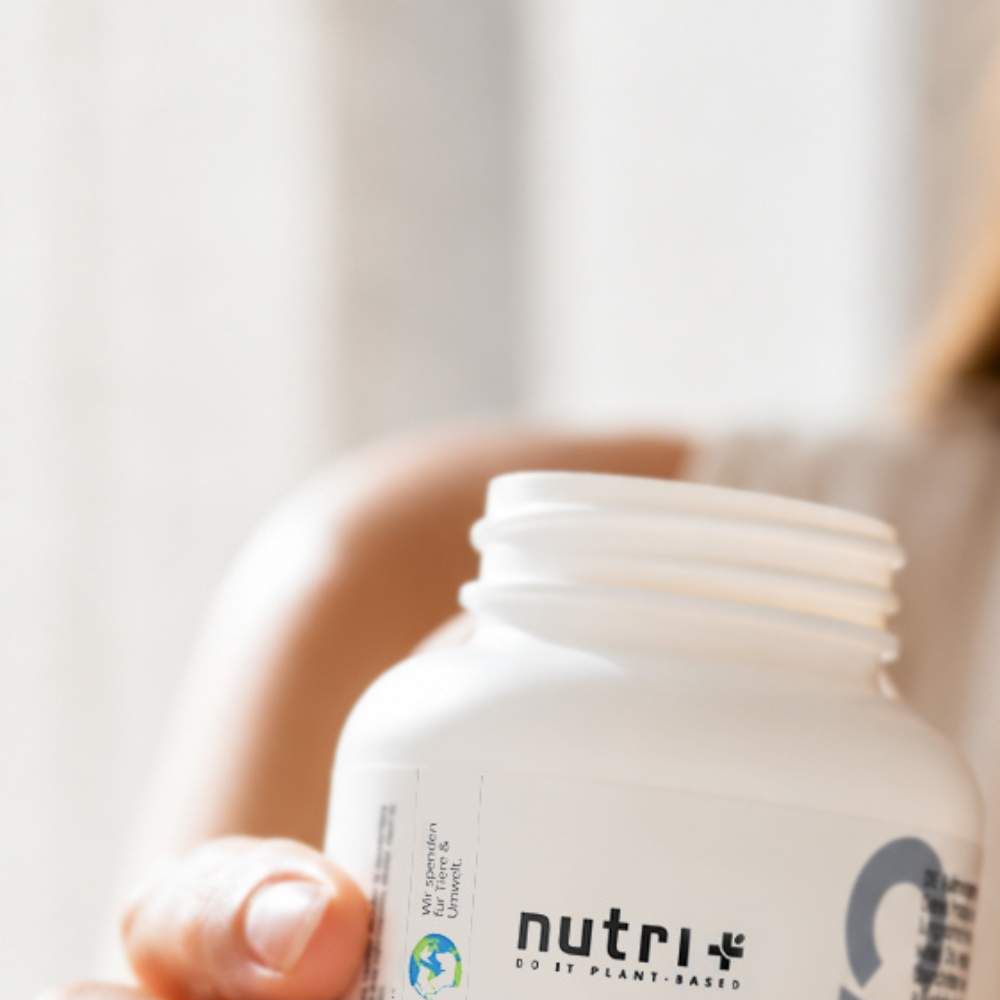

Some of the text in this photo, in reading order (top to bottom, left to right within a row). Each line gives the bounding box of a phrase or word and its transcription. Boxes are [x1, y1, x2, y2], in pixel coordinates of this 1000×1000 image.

[439, 840, 450, 854] &
[421, 822, 438, 917] Wir spenden
[435, 856, 449, 893] Tiere
[447, 857, 463, 919] Umwelt.
[515, 957, 741, 990] DO IT PLANT-BASED
